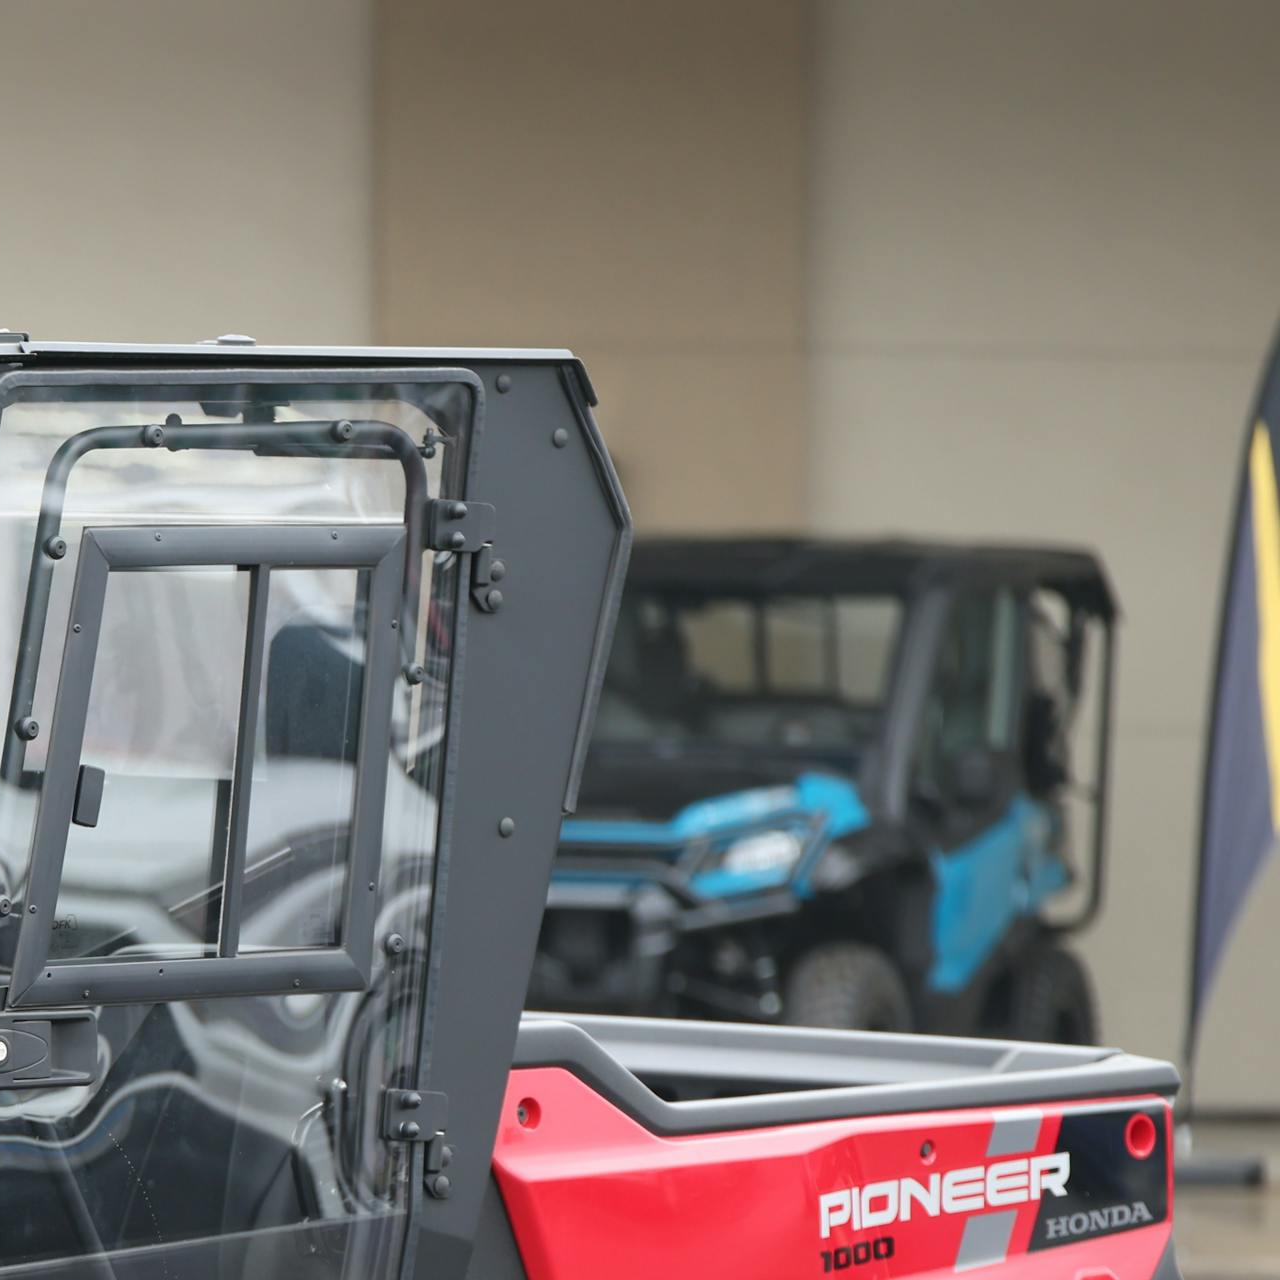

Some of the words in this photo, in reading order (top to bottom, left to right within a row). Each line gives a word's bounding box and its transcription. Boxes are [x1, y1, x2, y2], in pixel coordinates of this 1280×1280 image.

[819, 1152, 1071, 1239] PIONEER
[1046, 1201, 1153, 1240] HONDA
[819, 1237, 895, 1274] 1000
